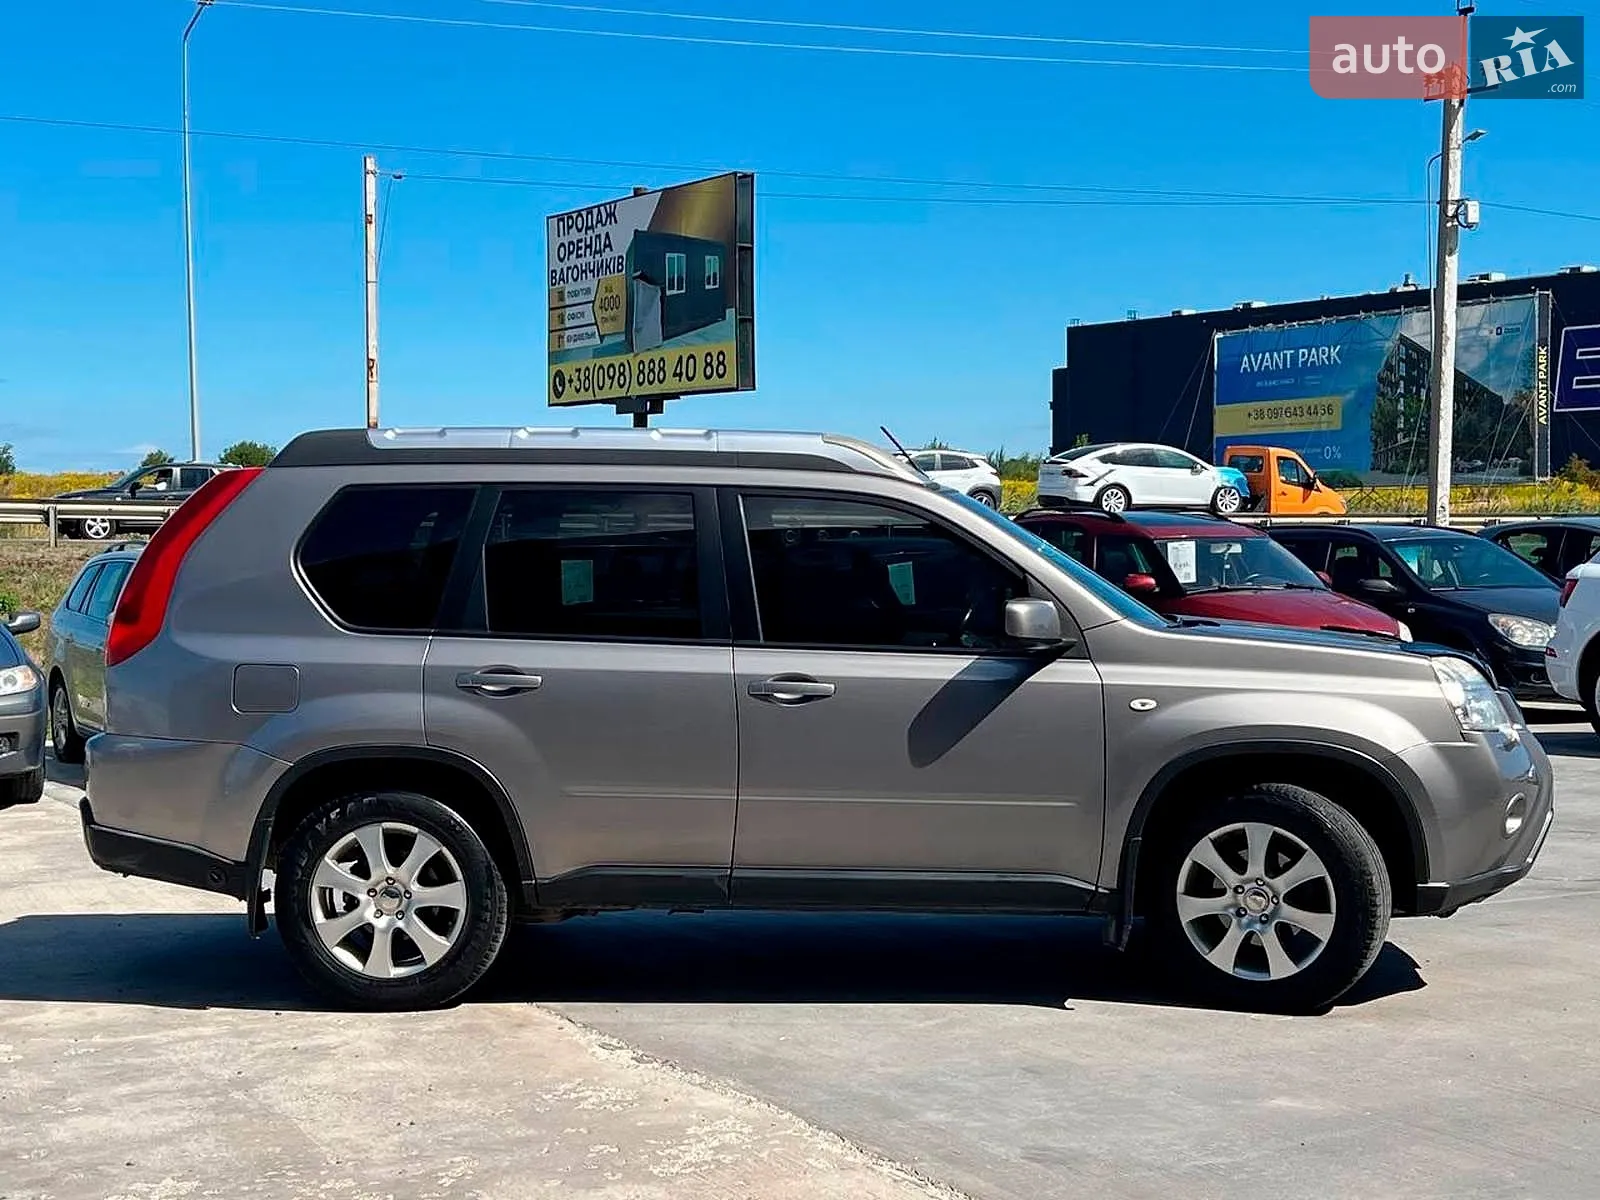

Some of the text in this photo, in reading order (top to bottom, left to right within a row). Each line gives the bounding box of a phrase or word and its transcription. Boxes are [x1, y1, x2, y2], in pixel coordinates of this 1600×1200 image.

[556, 204, 618, 237] ПРОДАЖ
[557, 232, 613, 262] ОРЕНДА
[551, 255, 625, 286] ВАГОНЧИКІВ
[598, 295, 621, 312] 4000
[568, 350, 727, 397] +38(098) 888 40 88
[1240, 345, 1341, 374] AVANT PARK
[1538, 346, 1548, 425] AVANT PARK
